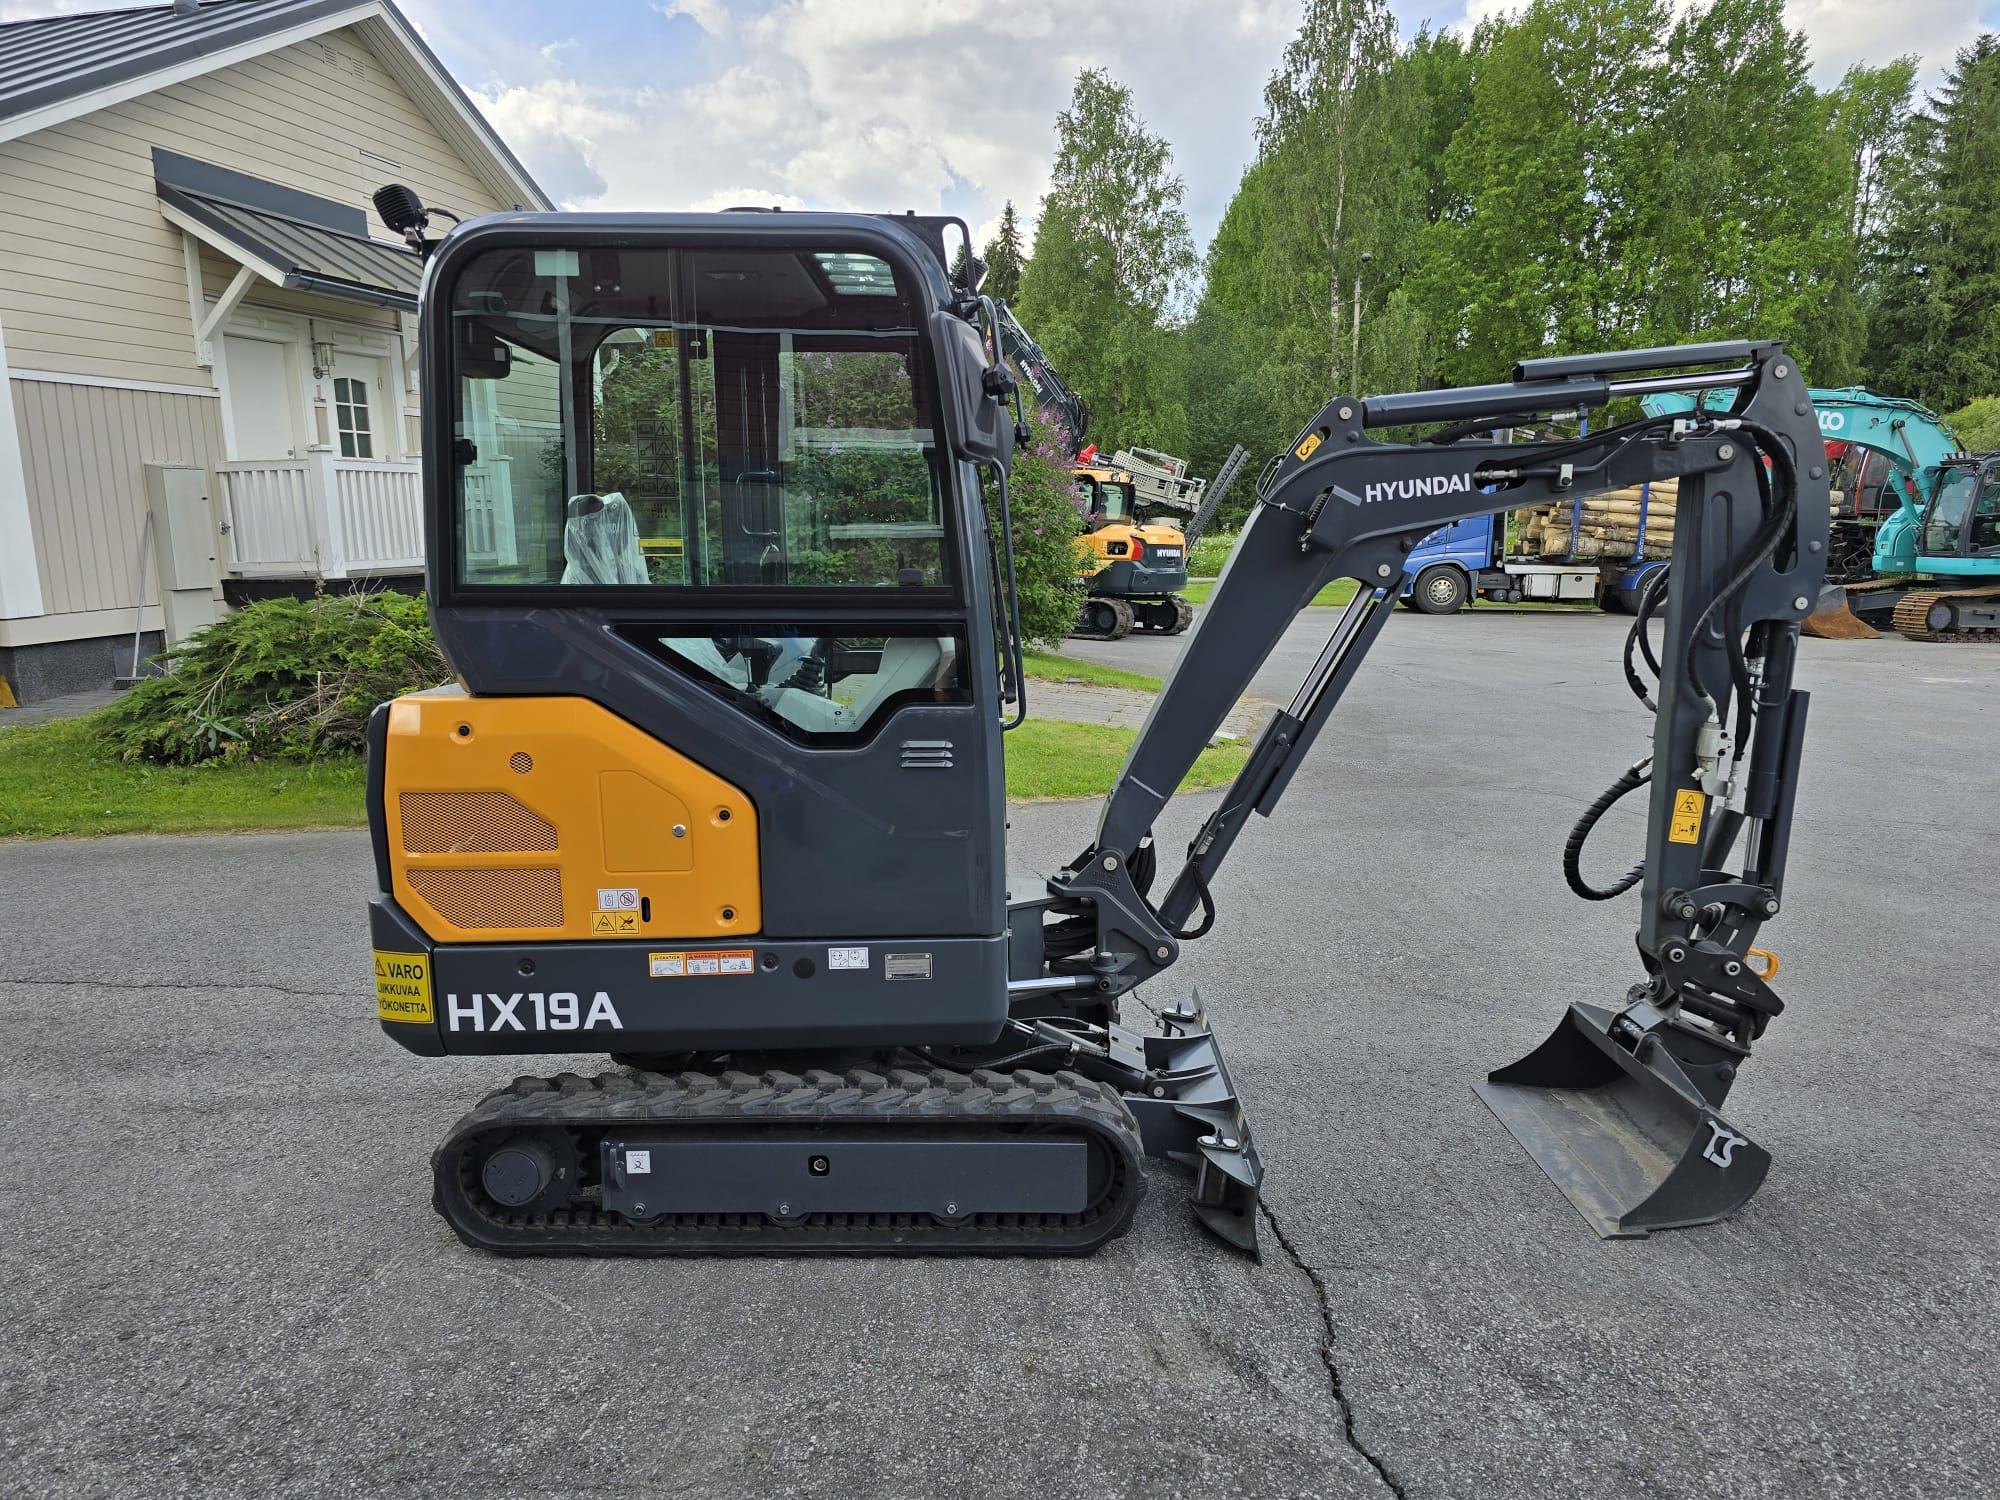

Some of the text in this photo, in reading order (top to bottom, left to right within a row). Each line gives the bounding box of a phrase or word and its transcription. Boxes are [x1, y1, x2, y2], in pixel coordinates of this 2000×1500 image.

[1365, 472, 1471, 503] HYUNDAI
[1156, 548, 1181, 558] HYUNDAI
[387, 962, 424, 980] VARO
[377, 982, 421, 997] LIIKKUVAA
[378, 998, 428, 1014] YÖKONETTA
[447, 991, 623, 1032] HX19A
